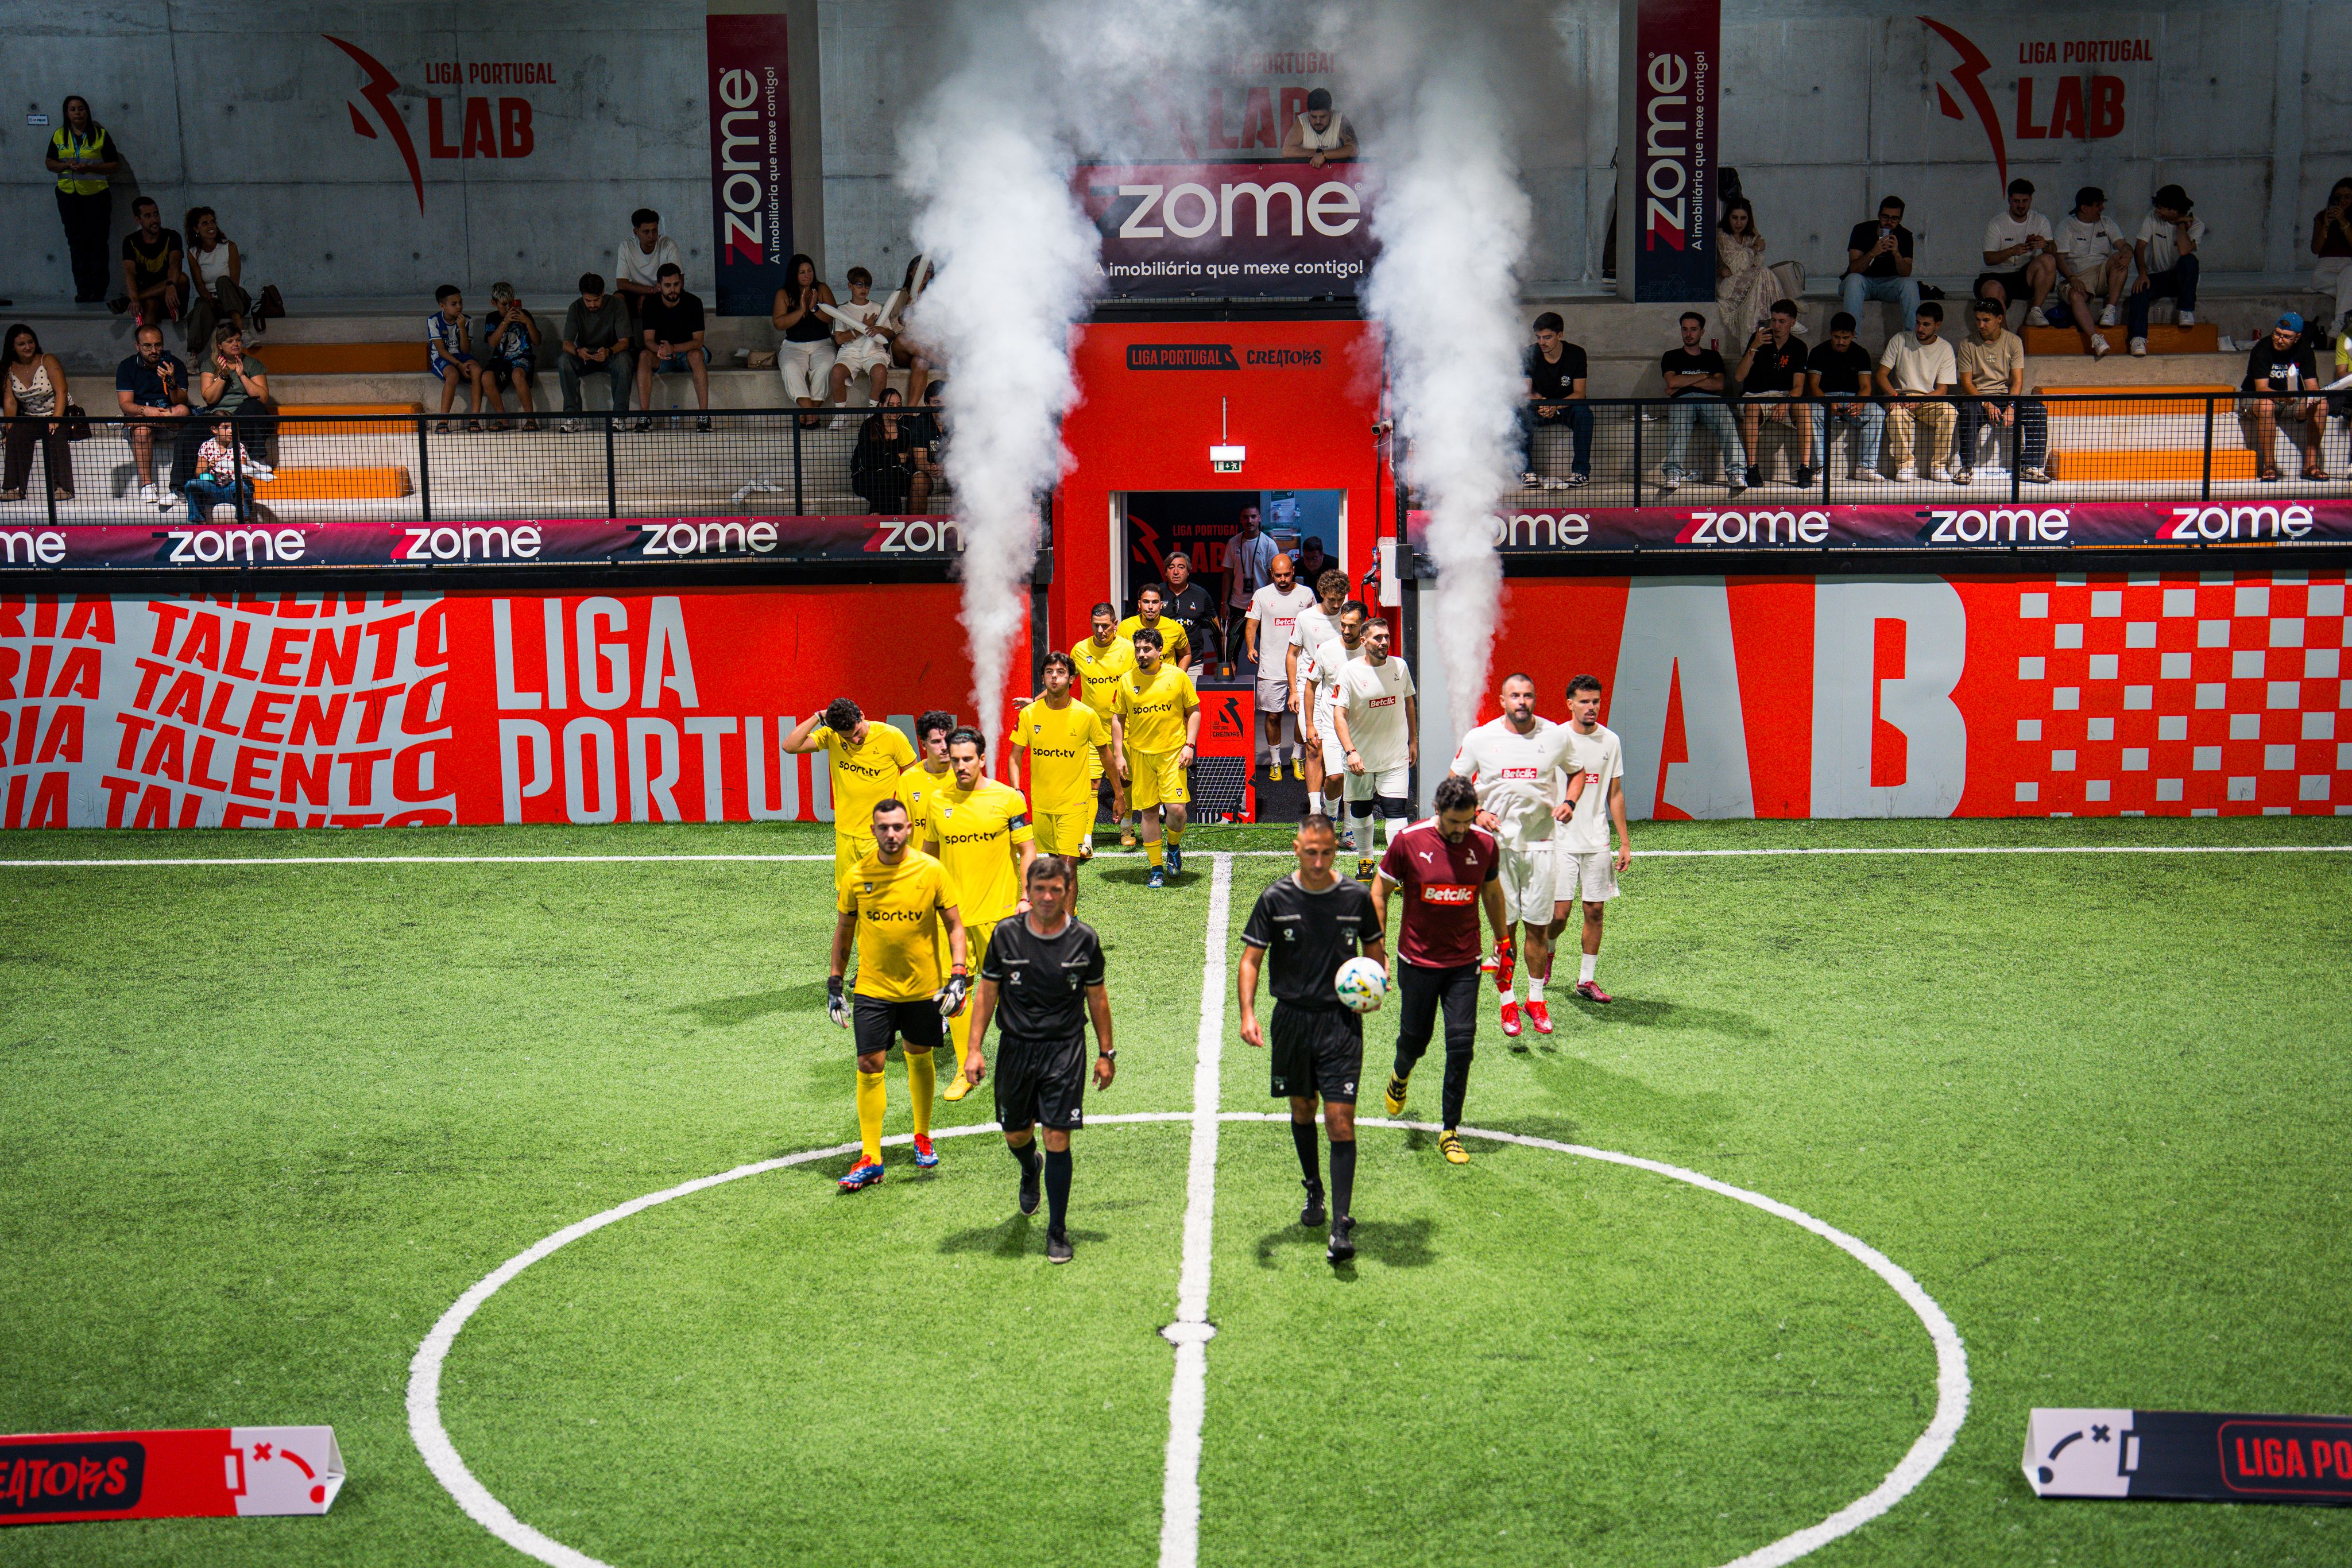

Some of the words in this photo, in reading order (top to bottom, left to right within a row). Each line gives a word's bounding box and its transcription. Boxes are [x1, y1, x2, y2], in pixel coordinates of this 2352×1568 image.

[1251, 52, 1340, 74] PORTUGAL
[2019, 41, 2057, 64] LIGA
[2064, 39, 2153, 63] PORTUGAL
[426, 62, 462, 84] LIGA
[469, 62, 556, 84] PORTUGAL
[1694, 52, 1708, 103] contigo!
[764, 66, 778, 118] contigo!
[2016, 75, 2126, 140] LAB
[430, 96, 535, 159] LAB
[768, 121, 777, 154] mexe
[1696, 106, 1704, 139] mexe
[719, 69, 763, 265] zome
[1646, 53, 1688, 251] zome
[1695, 142, 1705, 167] que
[769, 157, 780, 182] que
[768, 184, 779, 251] imobiliária
[1091, 181, 1361, 239] zome
[1692, 170, 1703, 237] imobiliária
[770, 253, 780, 265] A
[1692, 240, 1701, 250] A
[1109, 261, 1201, 277] imobiliária
[1206, 264, 1239, 278] que
[1244, 261, 1290, 275] mexe
[1294, 260, 1364, 279] contigo!
[1132, 350, 1158, 365] LIGA
[1160, 350, 1222, 365] PORTUGAL
[1247, 349, 1321, 367] CREATORS
[626, 522, 778, 555] zome
[864, 520, 965, 552] zom
[1173, 524, 1192, 536] LIGA
[1195, 524, 1238, 536] PORTUGAL
[1493, 513, 1589, 546] me
[1675, 510, 1829, 544] zome
[1915, 509, 2069, 541] zome
[2156, 505, 2313, 539] zome
[153, 528, 305, 563] zome
[390, 525, 541, 560] zome
[492, 595, 699, 710] LIGA
[1370, 697, 1395, 707] Betclic
[1503, 768, 1537, 779] Betclic
[1424, 886, 1475, 902] Betclic
[2235, 1437, 2307, 1478] LIGA
